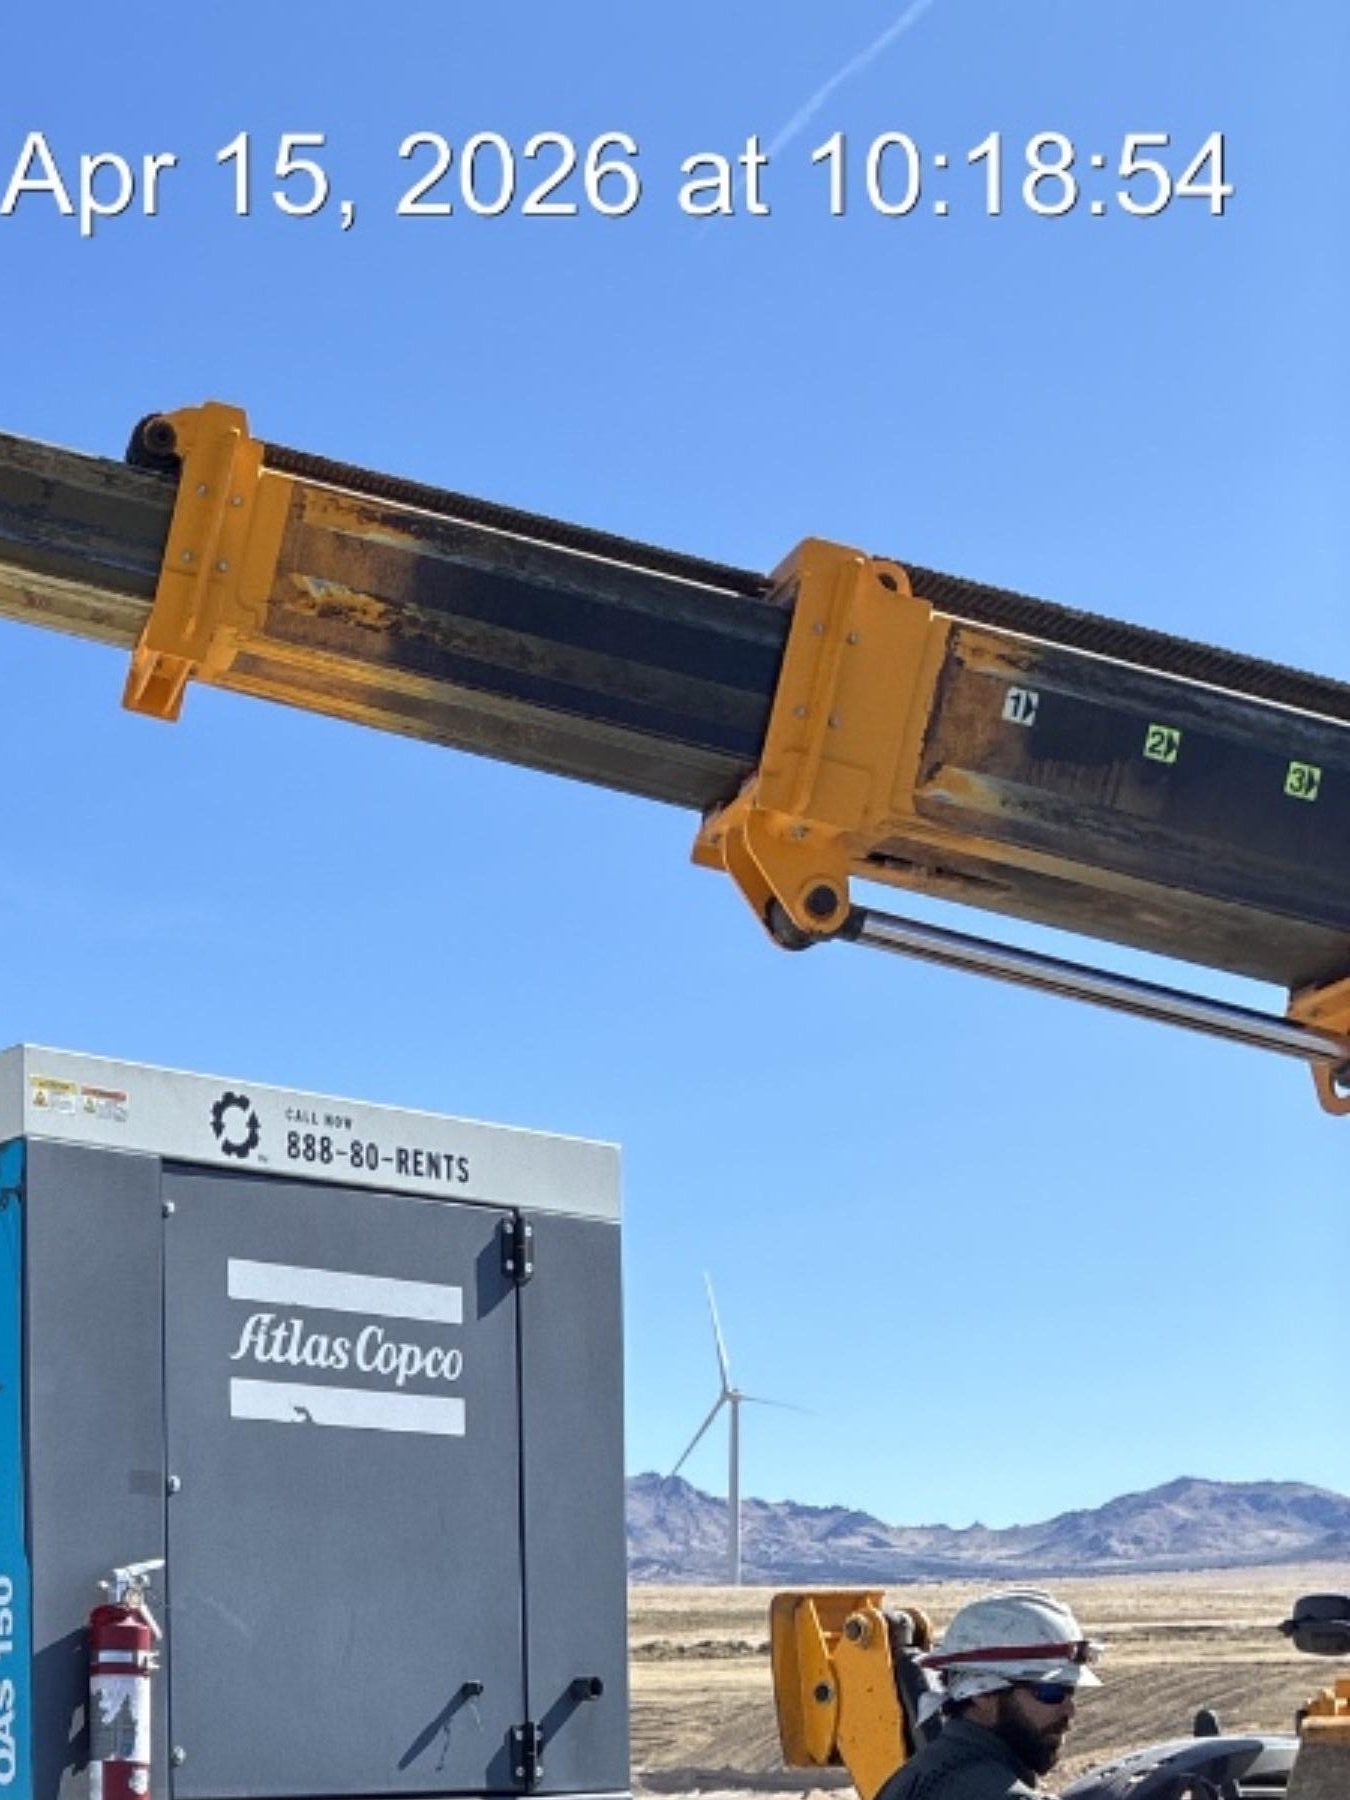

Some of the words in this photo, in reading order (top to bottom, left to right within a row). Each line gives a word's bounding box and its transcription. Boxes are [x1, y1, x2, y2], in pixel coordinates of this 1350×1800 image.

[1148, 731, 1164, 755] 2
[1289, 768, 1306, 792] 3
[285, 1106, 320, 1126] CALL
[324, 1115, 353, 1131] NOW
[286, 1130, 471, 1184] 888-80-RENTS
[230, 1312, 351, 1370] Atlas
[355, 1324, 464, 1388] Copco
